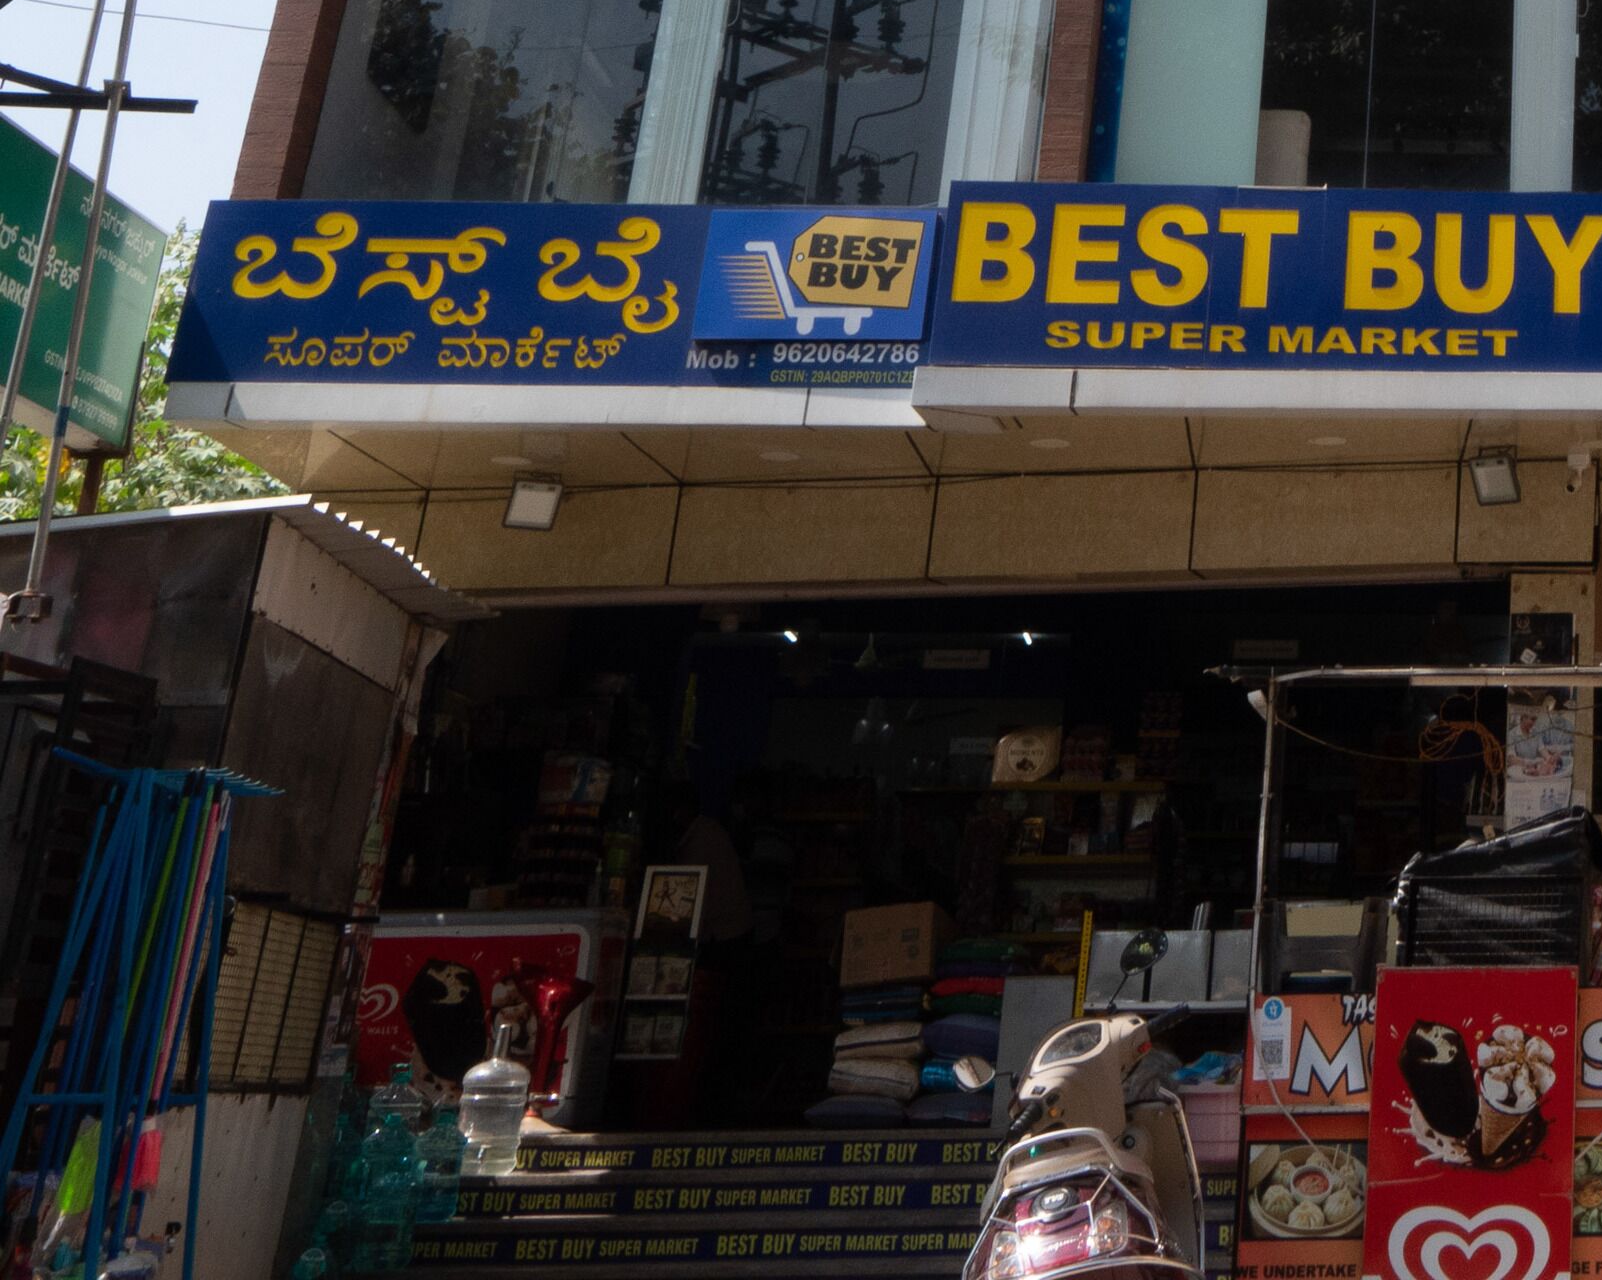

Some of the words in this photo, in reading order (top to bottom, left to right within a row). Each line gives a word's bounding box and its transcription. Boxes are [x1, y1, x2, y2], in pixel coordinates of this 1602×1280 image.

[808, 233, 917, 264] BEST
[951, 201, 1300, 308] BEST
[231, 211, 507, 328] ಬೆಸ್ಟ್
[538, 216, 680, 334] ಬೈ
[807, 261, 904, 292] BUY
[263, 326, 415, 368] ಸೂಪರ್
[438, 325, 628, 371] ಮಾರ್ಕೆಟ್
[1045, 321, 1246, 353] SUPER
[1268, 325, 1518, 357] MARKET
[685, 349, 739, 369] Mob
[772, 343, 920, 364] 9620642786
[516, 1148, 538, 1169] UY
[540, 1150, 582, 1168] SUPER
[584, 1150, 636, 1167] MARKET
[651, 1147, 691, 1169] BEST
[696, 1146, 727, 1169] BUY
[730, 1147, 772, 1165] SUPER
[775, 1145, 826, 1164] MARKET
[842, 1143, 881, 1163] BEST
[887, 1142, 918, 1162] BUY
[943, 1143, 981, 1163] BEST
[482, 1191, 515, 1213] BUY
[520, 1193, 561, 1210] SUPER
[564, 1192, 616, 1209] MARKET
[633, 1189, 673, 1211] BEST
[678, 1188, 712, 1210] BUY
[715, 1189, 756, 1208] SUPER
[760, 1187, 812, 1206] MARKET
[828, 1186, 868, 1207] BEST
[873, 1185, 906, 1206] BUY
[931, 1184, 971, 1206] BEST
[443, 1241, 498, 1258] MARKET
[515, 1239, 559, 1261] BEST
[562, 1238, 596, 1261] BUY
[599, 1239, 642, 1257] SUPER
[645, 1237, 699, 1256] MARKET
[716, 1235, 758, 1256] BEST
[762, 1233, 797, 1255] BUY
[800, 1234, 842, 1252] SUPER
[845, 1233, 900, 1252] MARKET
[902, 1232, 944, 1251] SUPER
[948, 1232, 978, 1249] MAR
[1263, 1263, 1357, 1279] UNDERTAKE
